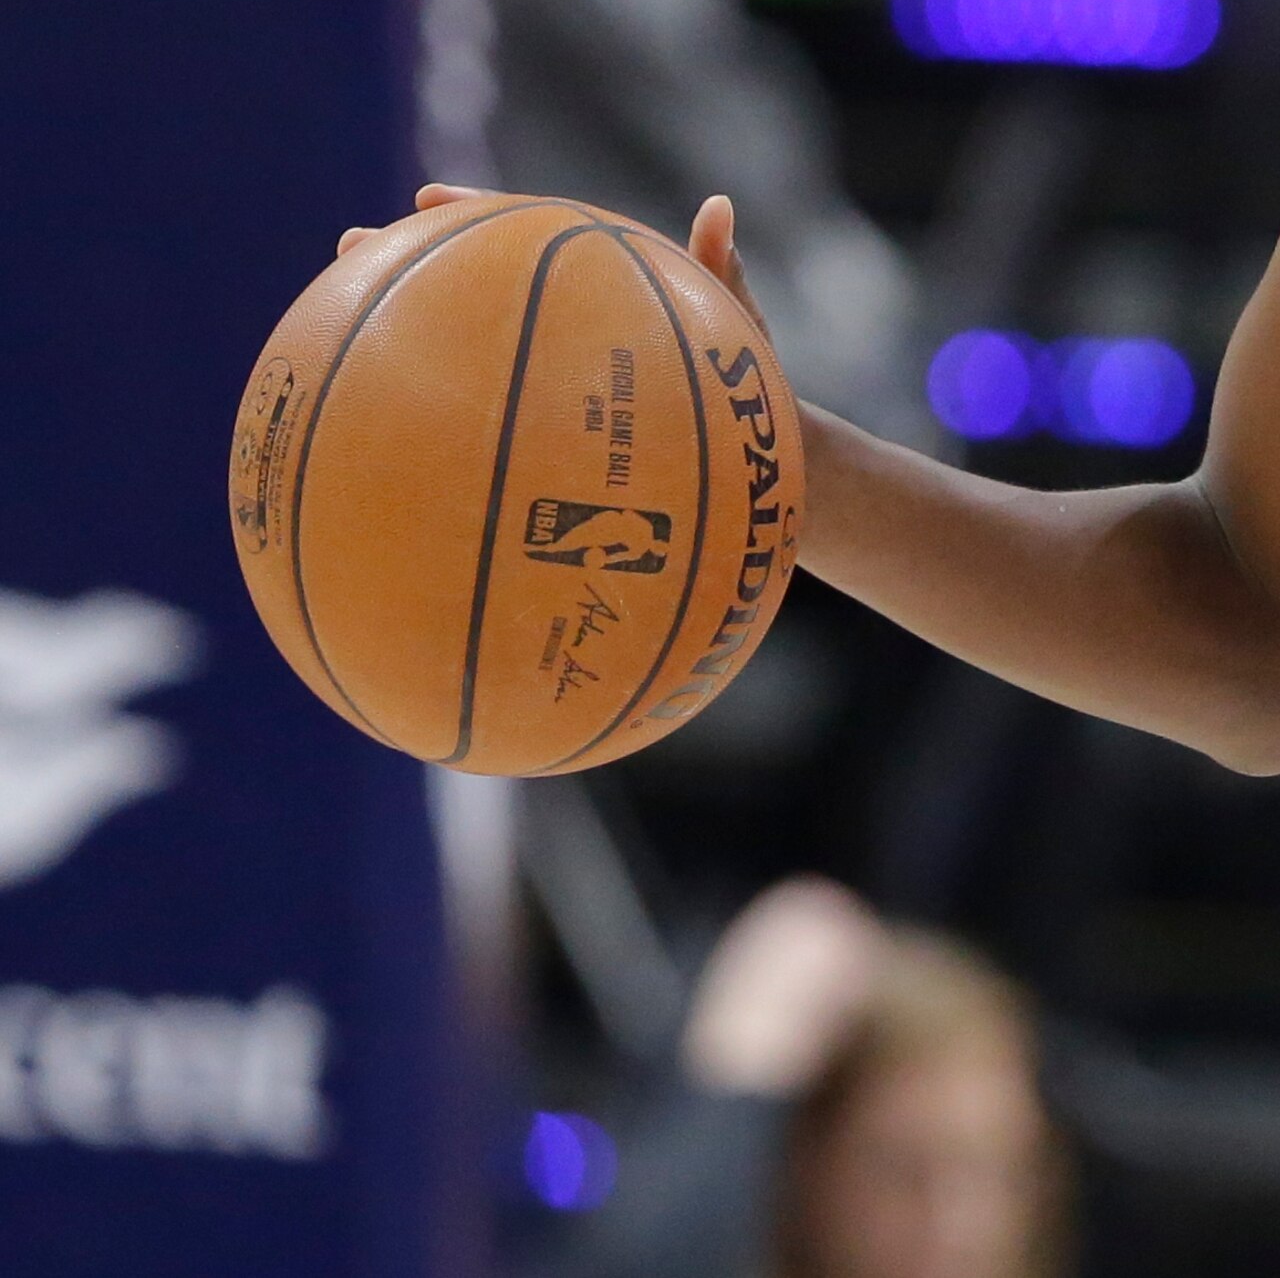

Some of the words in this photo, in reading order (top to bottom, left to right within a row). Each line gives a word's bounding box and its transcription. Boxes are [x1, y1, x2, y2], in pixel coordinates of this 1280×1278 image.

[610, 348, 634, 403] OFFICIAL
[583, 394, 605, 432] @NBA
[609, 410, 634, 450] GAME
[606, 453, 633, 488] BALL
[531, 501, 559, 543] NBA
[645, 345, 780, 720] SPALDING
